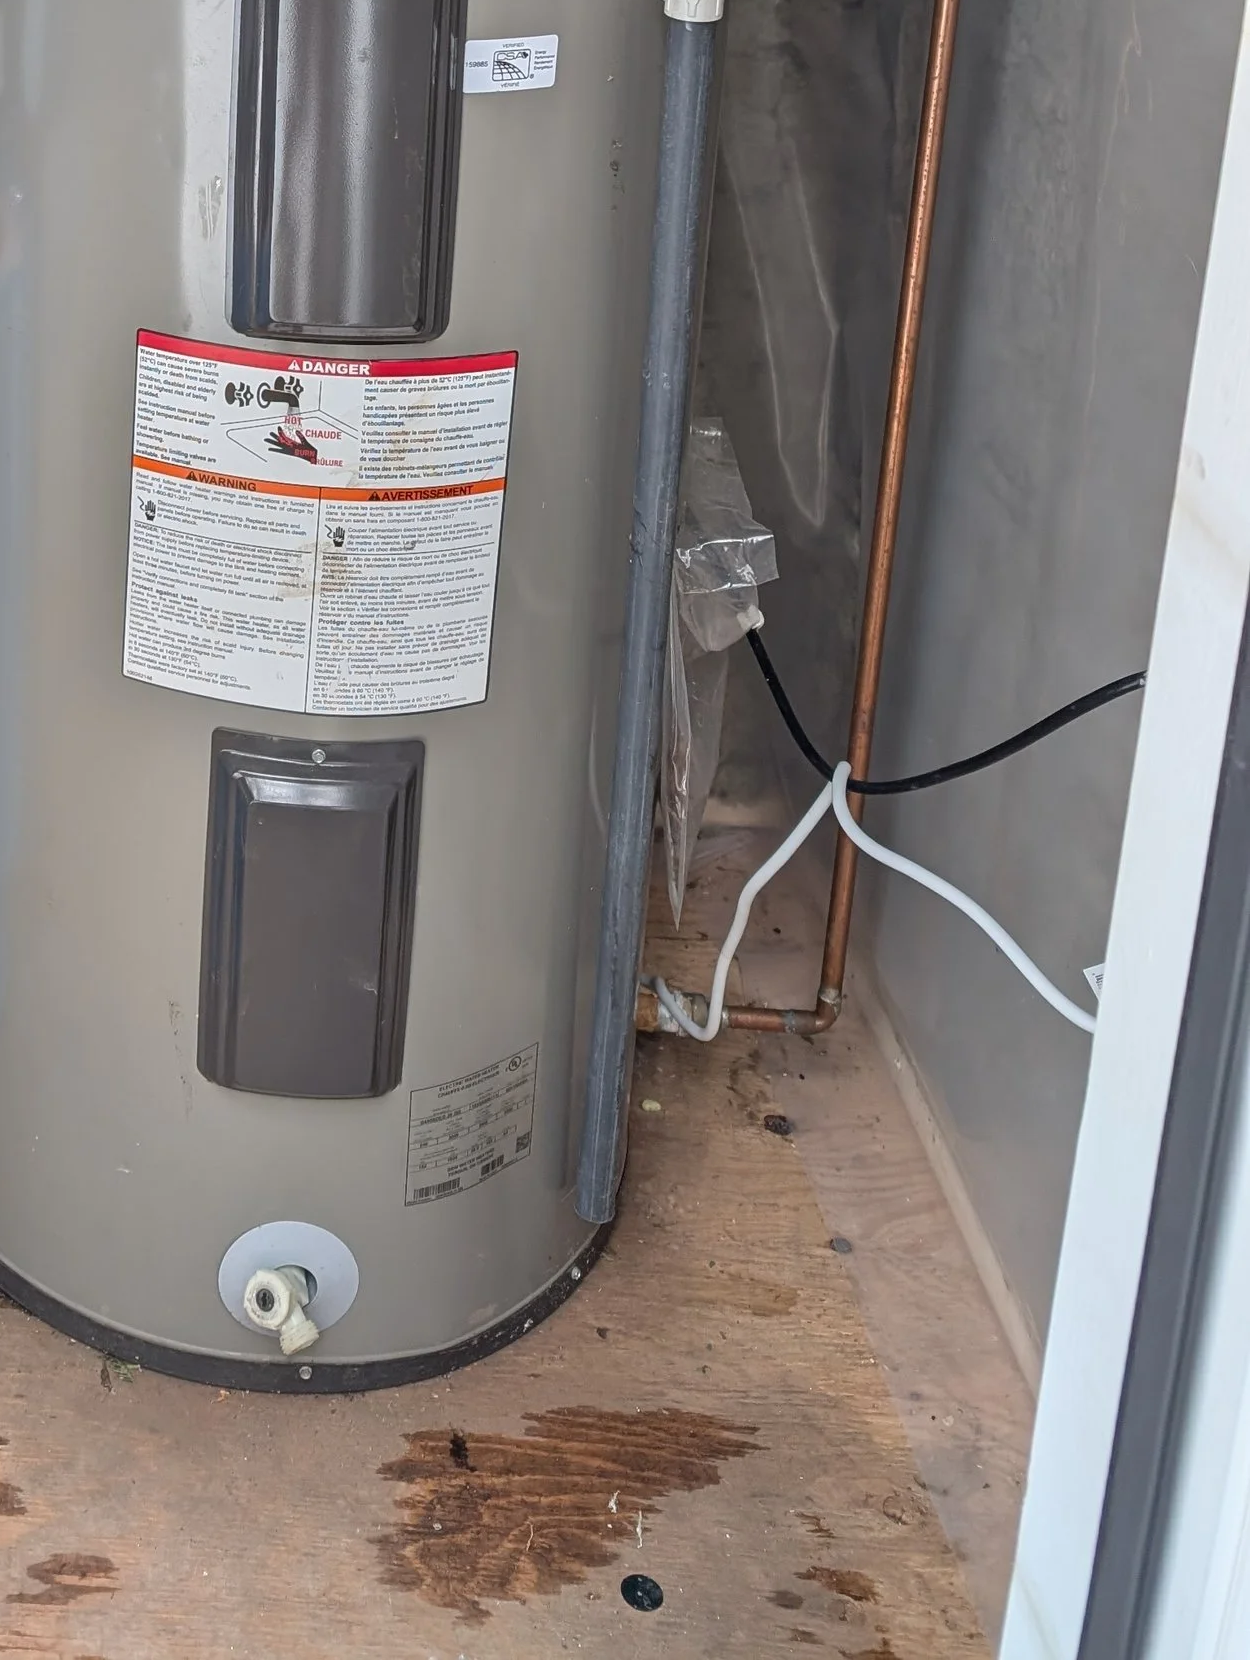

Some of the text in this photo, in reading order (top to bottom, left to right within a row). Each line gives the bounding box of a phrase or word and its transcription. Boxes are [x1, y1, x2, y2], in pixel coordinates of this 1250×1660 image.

[496, 51, 523, 60] CSA
[140, 348, 155, 356] Water
[167, 362, 183, 370] cause
[202, 369, 219, 377] burns
[168, 370, 184, 378] death
[302, 361, 370, 375] DANGER
[138, 373, 216, 395] Children, disabled and elderly
[153, 384, 173, 395] highest
[191, 393, 207, 402] being
[148, 401, 176, 412] instruction
[177, 407, 196, 416] manual
[197, 411, 215, 420] before
[155, 410, 187, 422] temperature
[285, 416, 302, 425] HOT
[148, 426, 162, 434] water
[163, 429, 180, 438] before
[181, 433, 202, 443] bathing
[305, 430, 341, 440] CHAUDE
[198, 473, 257, 492] WARNING
[381, 485, 474, 502] AVERTISSEMENT
